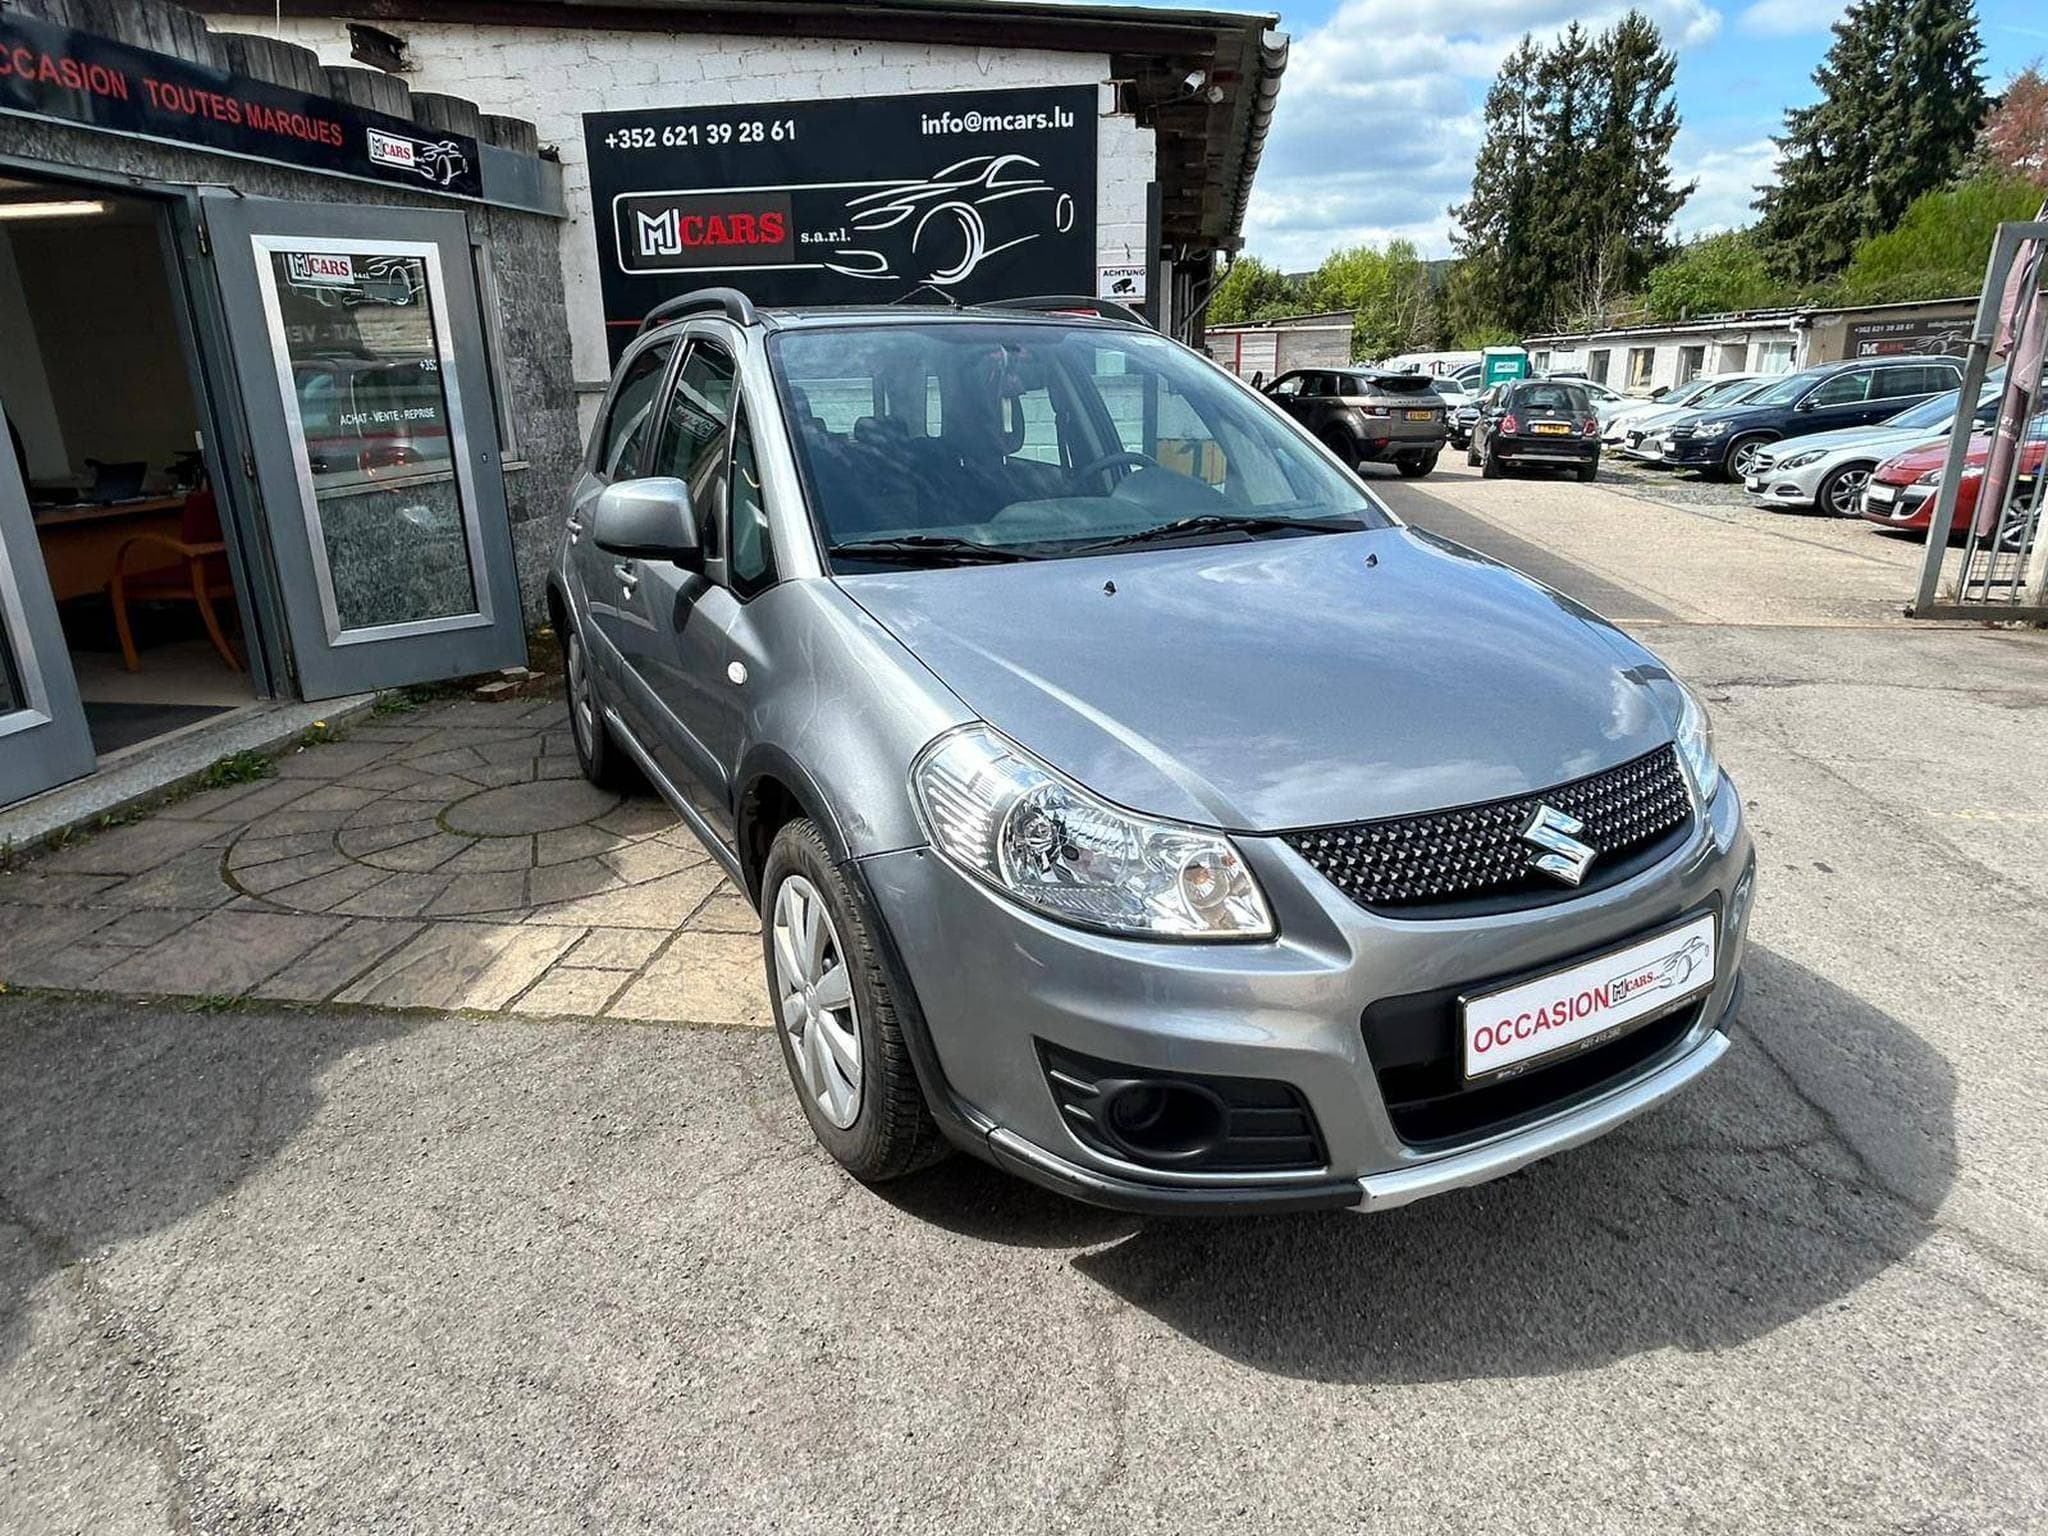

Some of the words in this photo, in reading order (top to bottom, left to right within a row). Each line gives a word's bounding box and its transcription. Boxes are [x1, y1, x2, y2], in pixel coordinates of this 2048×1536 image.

[143, 76, 241, 124] TOUTES
[245, 102, 343, 146] MARQUES
[922, 106, 1074, 134] info@mcars.lu
[605, 127, 656, 148] +352
[662, 125, 698, 146] 621
[706, 123, 732, 144] 39
[738, 121, 765, 143] 28
[771, 119, 795, 141] 61
[801, 228, 851, 243] s.a.r.l.
[341, 412, 367, 426] ACHAT
[372, 410, 399, 422] VENTE
[404, 407, 435, 419] REPRISE
[1473, 984, 1610, 1053] OCCASION
